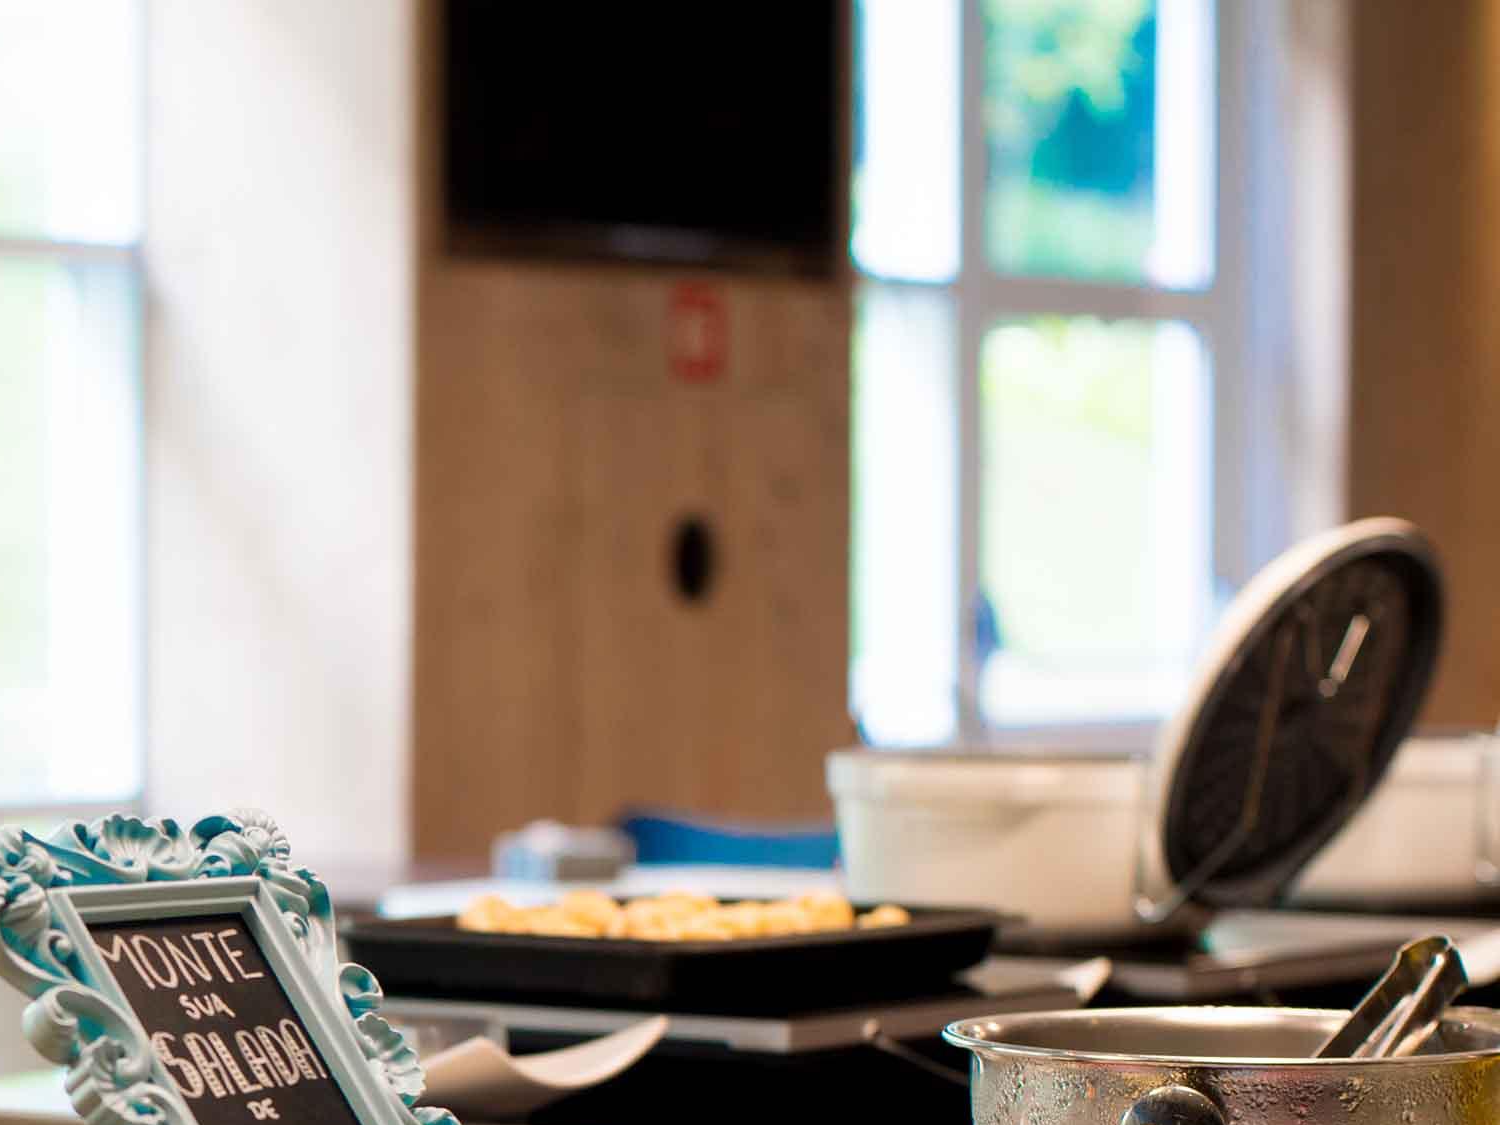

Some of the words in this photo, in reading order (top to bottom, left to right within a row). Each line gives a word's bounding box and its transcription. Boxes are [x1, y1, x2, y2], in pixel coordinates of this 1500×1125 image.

[95, 928, 264, 990] MONTE
[179, 994, 236, 1019] SUA
[151, 1018, 328, 1100] SALADA
[247, 1098, 280, 1121] DE
